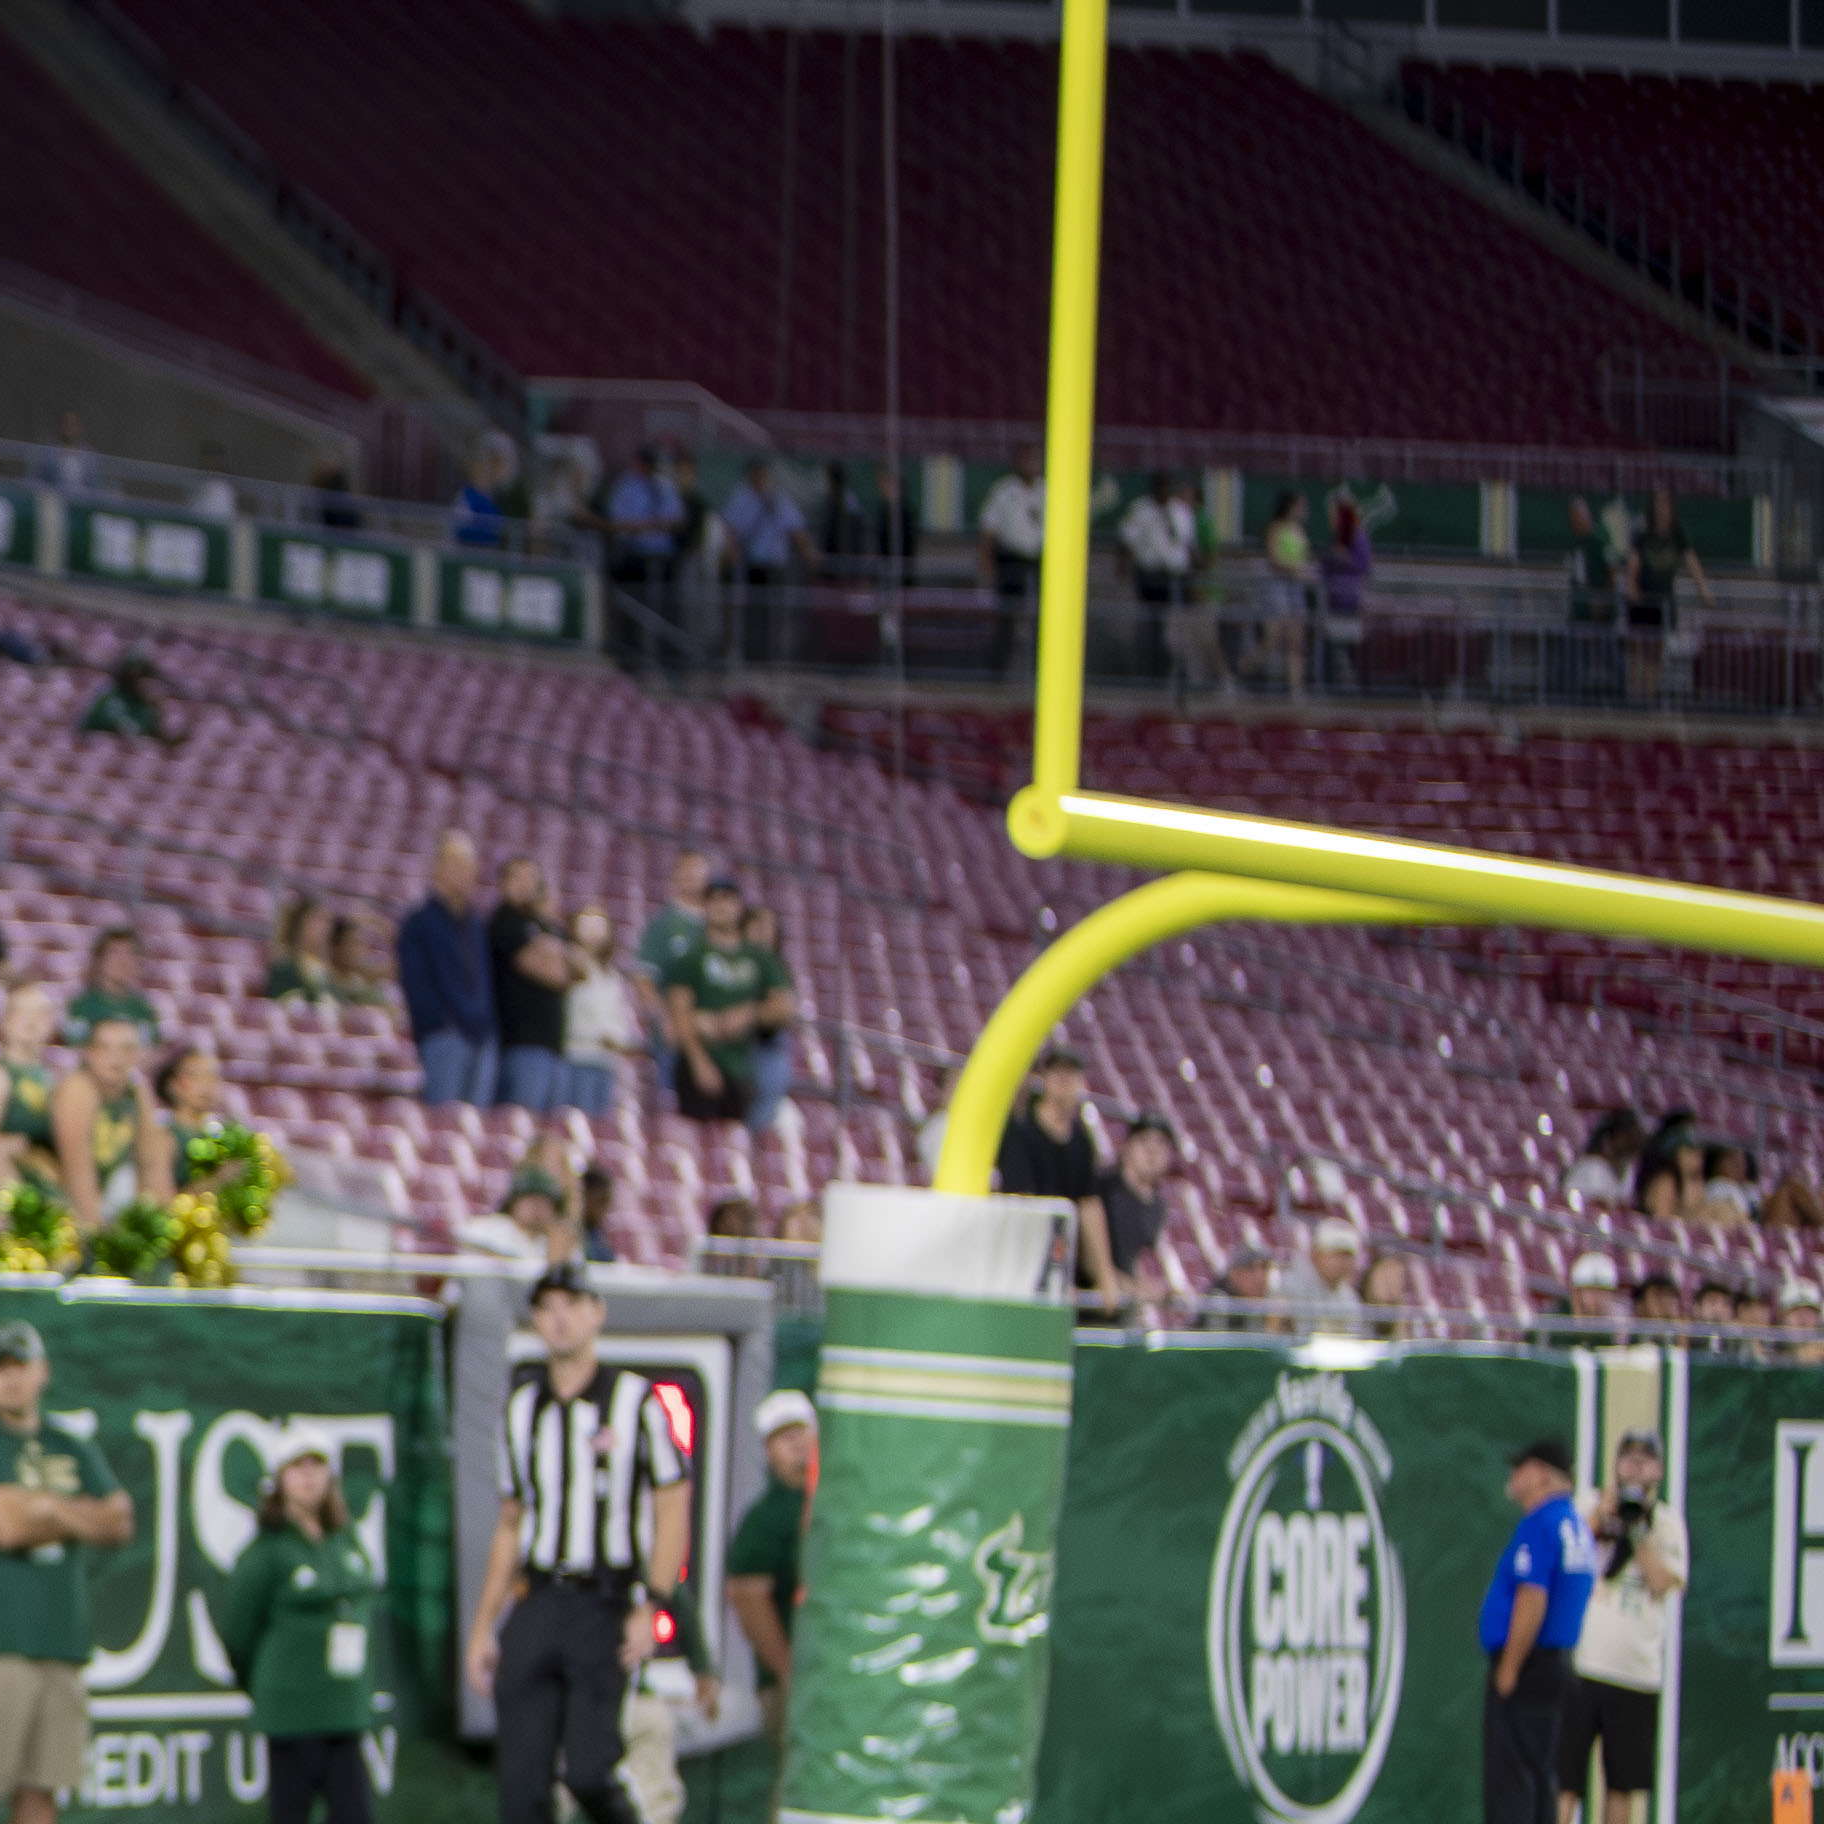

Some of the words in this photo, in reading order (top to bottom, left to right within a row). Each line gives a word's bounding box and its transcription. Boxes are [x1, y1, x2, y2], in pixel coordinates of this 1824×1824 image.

[1254, 1511, 1370, 1650] CORE
[1254, 1651, 1368, 1755] POWER
[55, 1731, 213, 1809] EDIT
